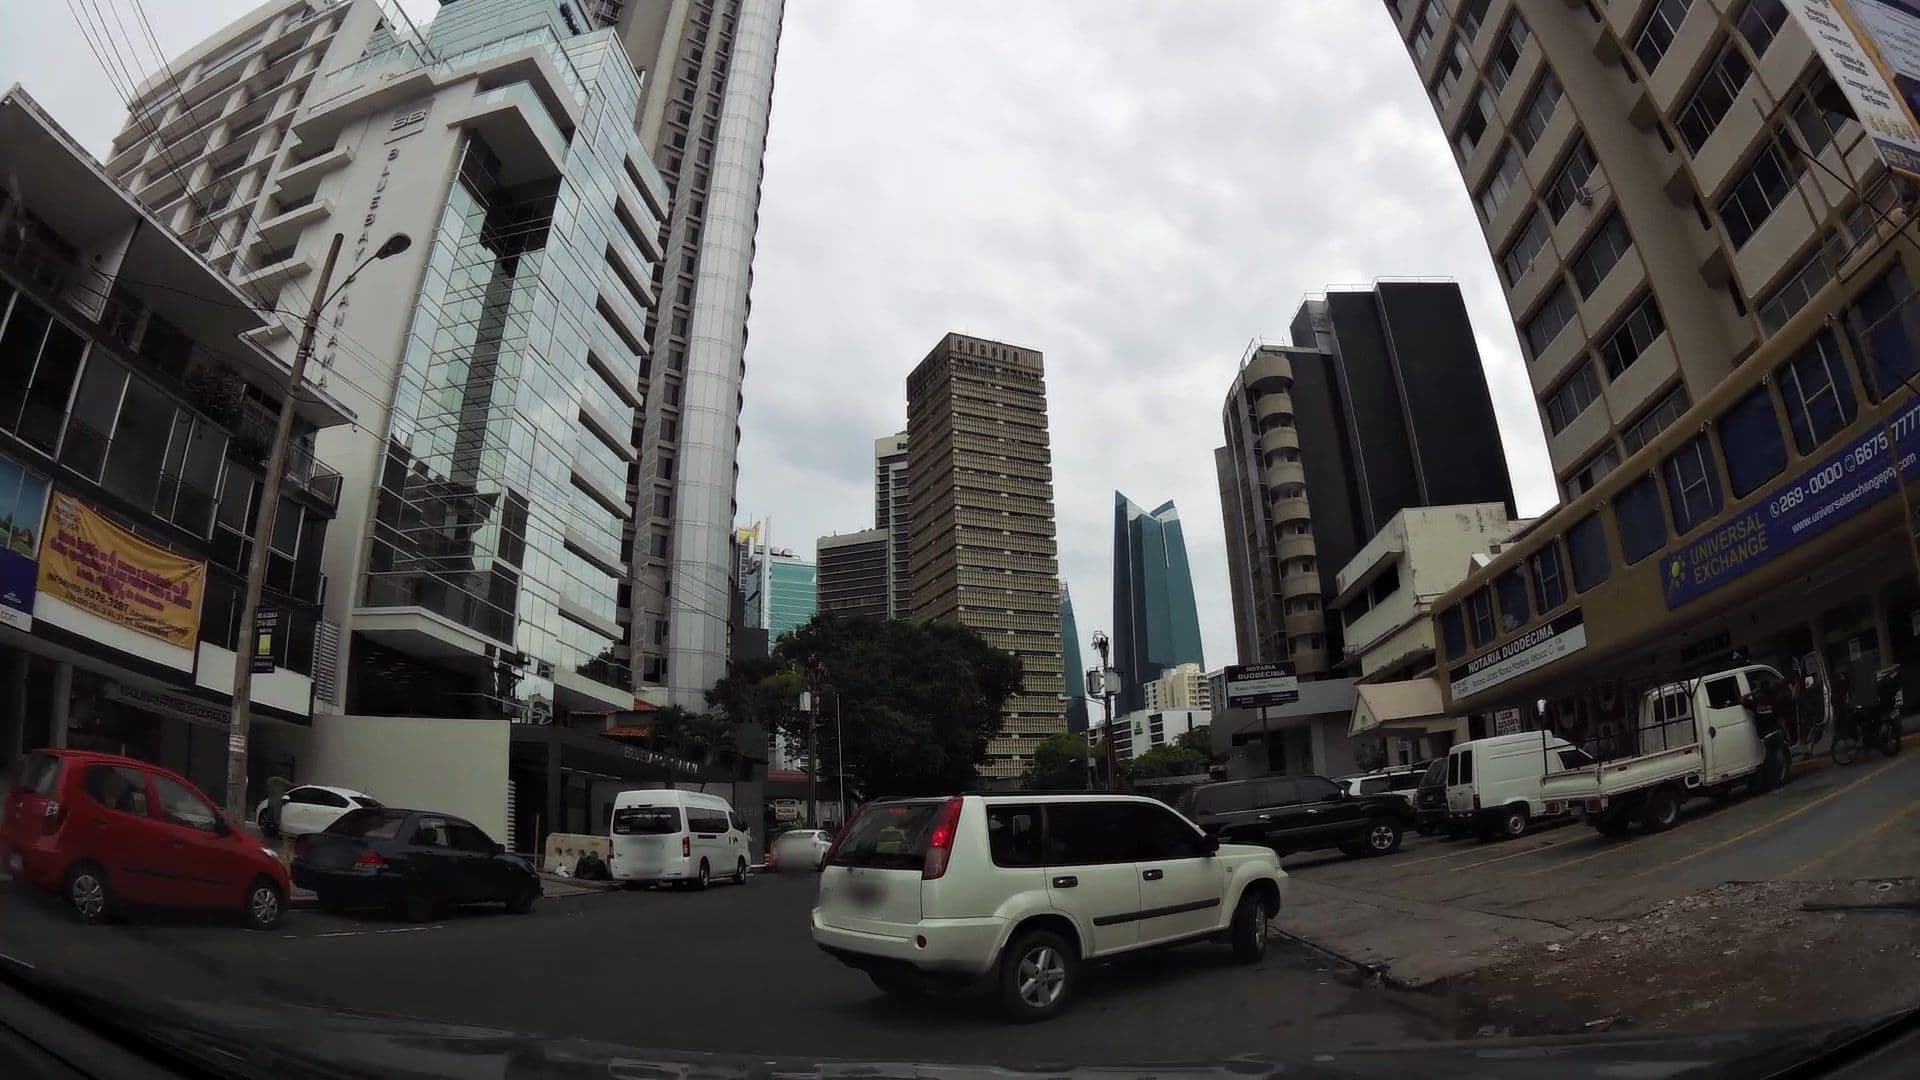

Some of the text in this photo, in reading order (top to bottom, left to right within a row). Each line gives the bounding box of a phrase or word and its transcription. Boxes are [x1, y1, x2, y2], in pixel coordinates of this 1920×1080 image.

[391, 110, 427, 131] BB
[1855, 431, 1889, 466] 6675
[1689, 512, 1766, 565] UNIVERSAL
[1693, 530, 1769, 585] EXCHANGE
[1246, 664, 1277, 672] NOTARIA
[1467, 651, 1501, 674] NOTARIA
